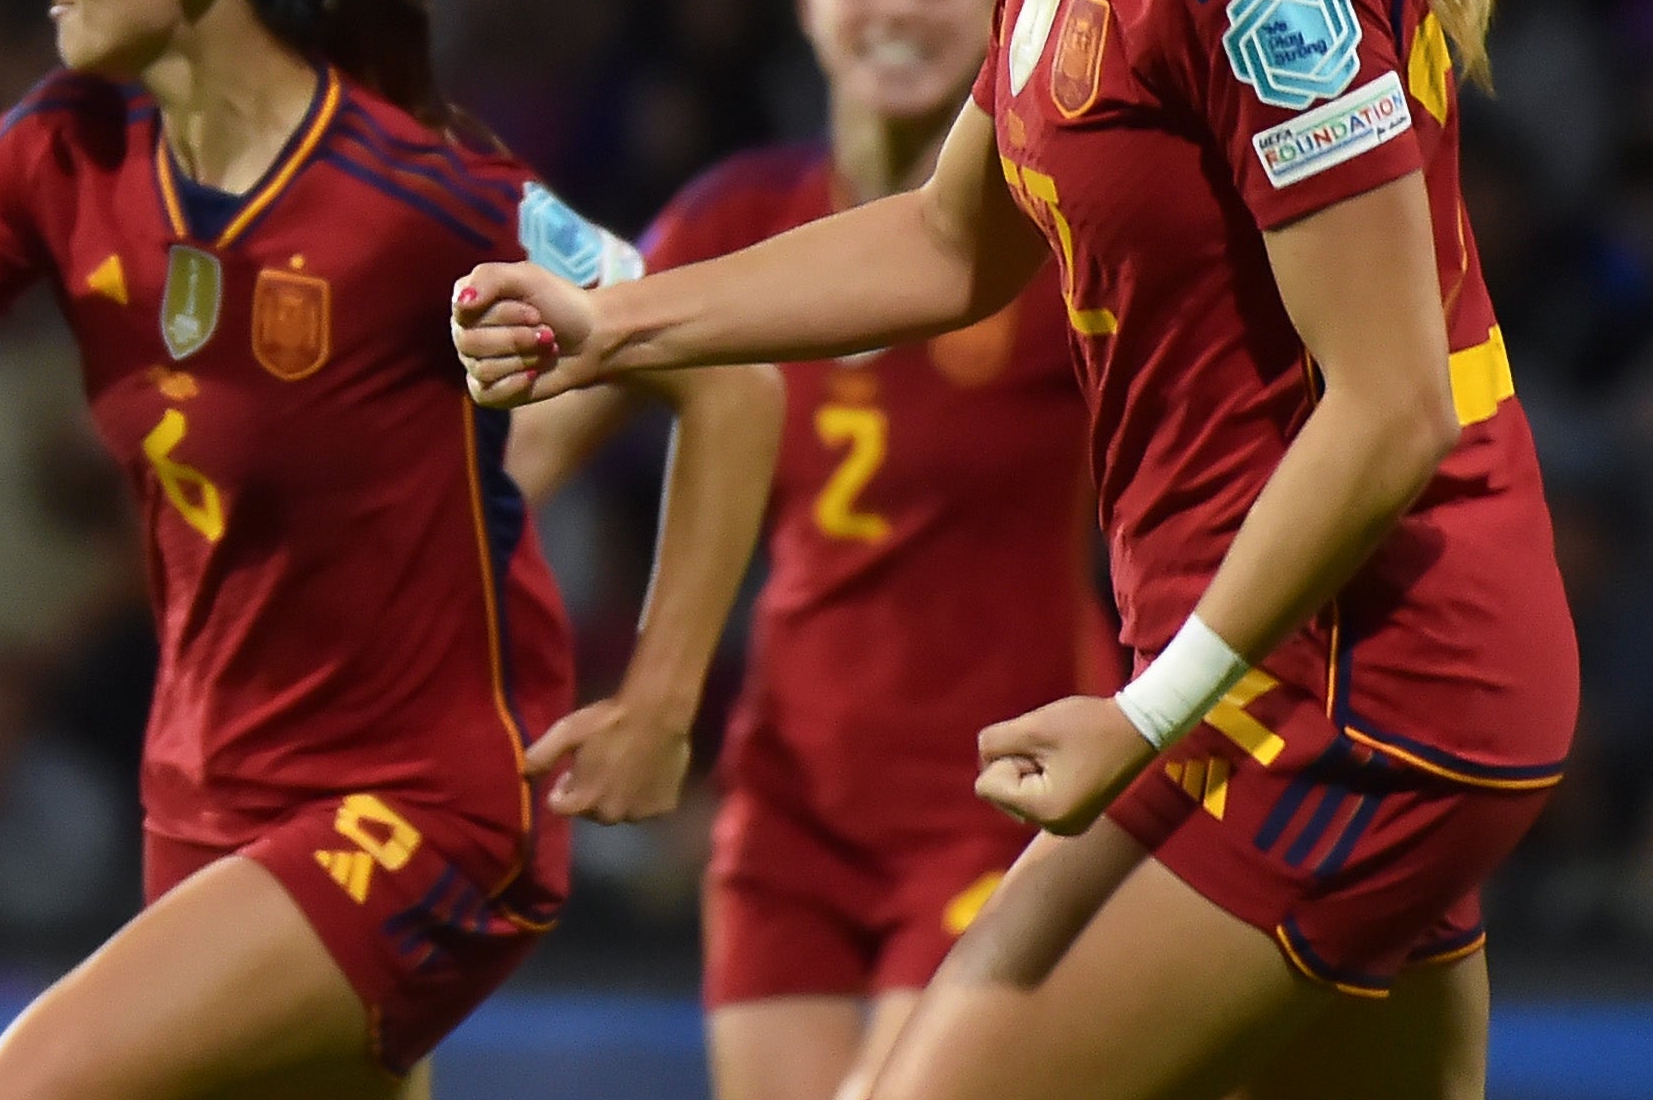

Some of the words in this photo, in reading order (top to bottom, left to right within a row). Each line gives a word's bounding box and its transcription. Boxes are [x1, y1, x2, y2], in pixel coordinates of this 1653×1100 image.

[1258, 128, 1293, 149] UEFA
[1263, 93, 1404, 170] FOUNDATION
[141, 407, 225, 543] 6
[812, 405, 890, 544] 2
